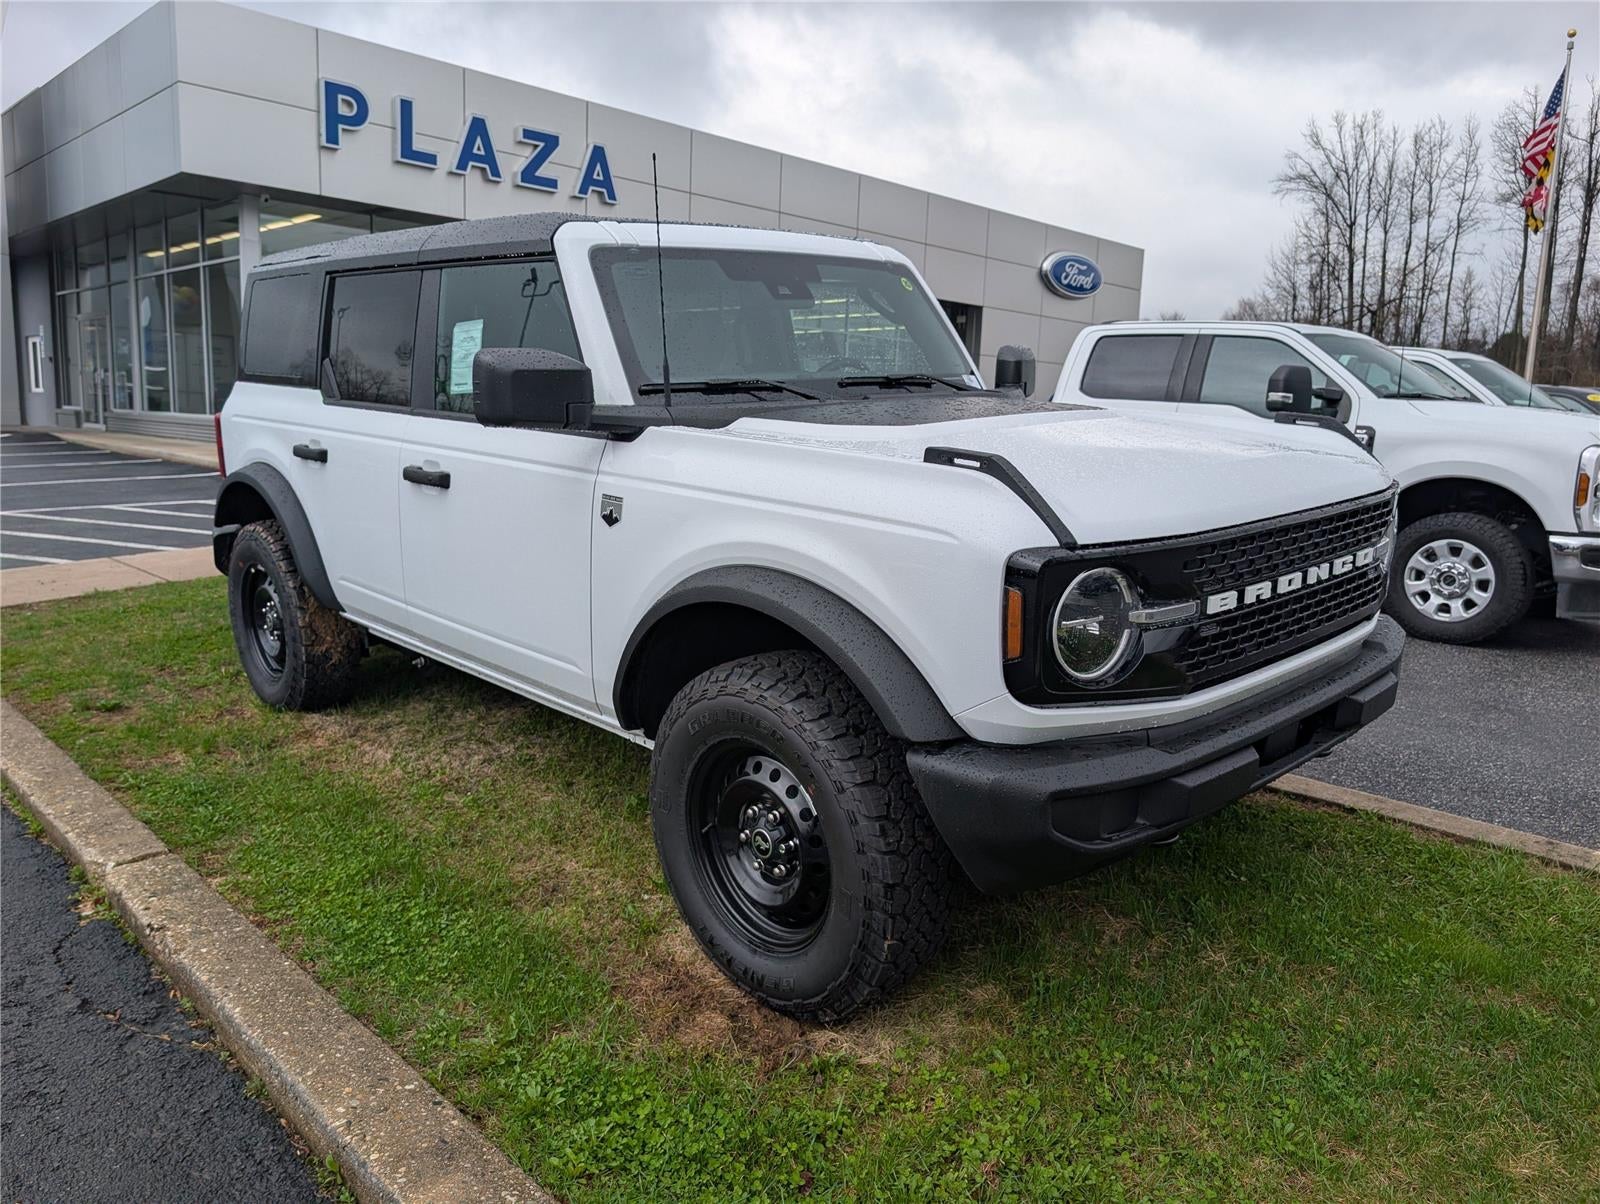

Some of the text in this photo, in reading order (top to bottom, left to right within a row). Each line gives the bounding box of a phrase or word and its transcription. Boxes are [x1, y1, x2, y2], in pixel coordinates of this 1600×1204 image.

[320, 78, 617, 204] PLAZA
[1060, 261, 1095, 290] Ford
[1206, 547, 1374, 615] BRONCO
